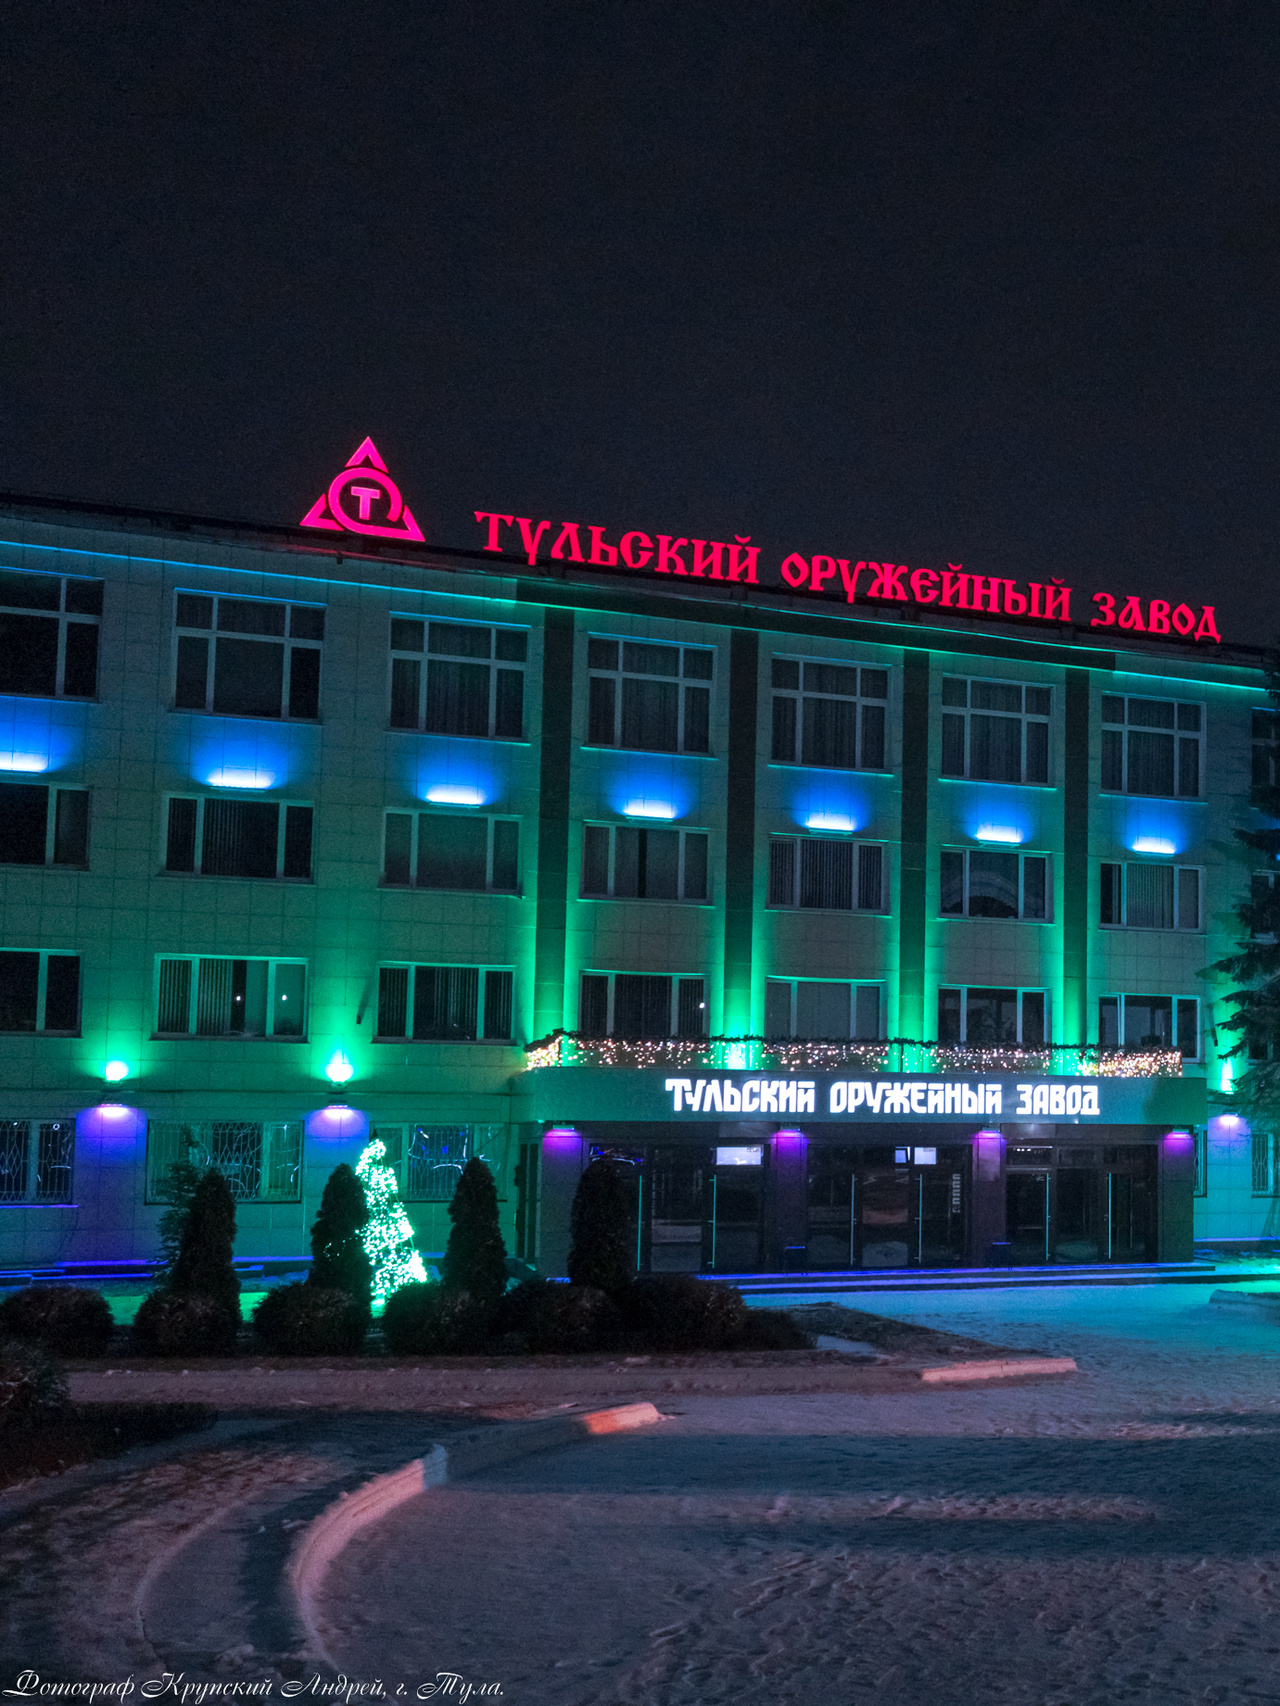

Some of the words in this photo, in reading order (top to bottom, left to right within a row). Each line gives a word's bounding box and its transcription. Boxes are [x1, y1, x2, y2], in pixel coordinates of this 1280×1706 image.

[351, 486, 381, 520] Т
[474, 511, 761, 583] ТУЛЬСКИЙ
[781, 552, 1072, 622] ОРУЖЕЙНЫЙ
[1091, 592, 1221, 643] ЗАВОД
[664, 1078, 815, 1113] ТУЛЬСКИЙ
[827, 1081, 1002, 1115] ОРУЖЕЙНЫЙ
[1015, 1083, 1100, 1116] ЗАВОД
